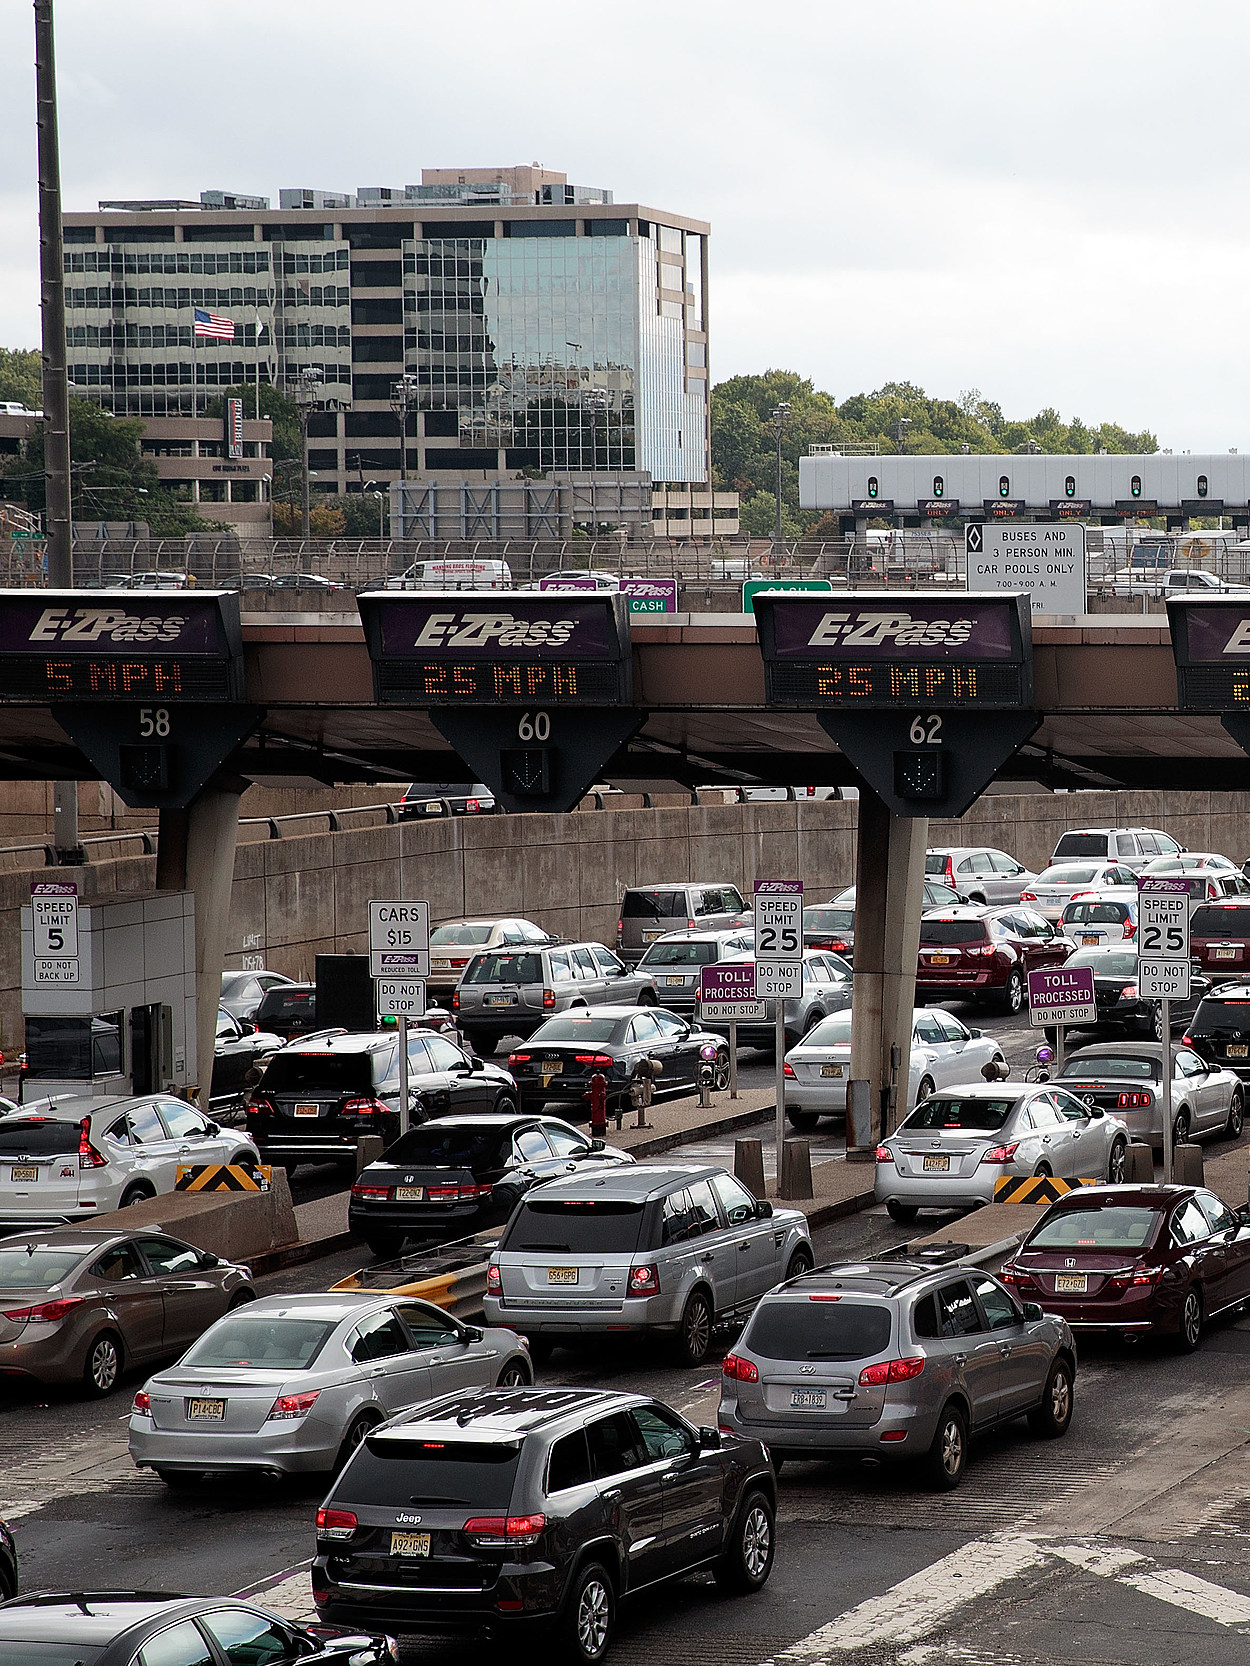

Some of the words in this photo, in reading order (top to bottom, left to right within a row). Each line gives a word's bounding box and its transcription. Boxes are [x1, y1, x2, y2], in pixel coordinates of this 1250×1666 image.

[1003, 532, 1037, 541] BUSES
[1045, 532, 1066, 541] AND
[993, 549, 1000, 557] 3
[1006, 548, 1048, 557] PERSON
[1055, 548, 1076, 557] MIN.
[977, 565, 998, 574] CAR
[1005, 565, 1040, 574] POOLS
[1047, 564, 1074, 574] ONLY
[622, 583, 675, 597] E-ZPass
[632, 601, 663, 611] CASH
[29, 609, 185, 642] E-ZPass
[415, 613, 576, 647] E-ZPass
[808, 612, 974, 647] E-ZPass
[46, 664, 72, 690] 5
[90, 664, 182, 692] MPH
[424, 666, 477, 694] 25
[500, 666, 578, 695] MPH
[817, 668, 873, 696] 25
[890, 668, 977, 697] MPH
[140, 709, 170, 737] 58
[518, 712, 550, 740] 60
[909, 715, 941, 744] 62
[34, 884, 75, 894] E-ZPass
[758, 882, 799, 892] E-ZPass
[1142, 880, 1186, 892] E-ZPass
[36, 902, 74, 913] SPEED
[760, 901, 797, 912] SPEED
[1144, 899, 1184, 911] SPEED
[41, 915, 70, 925] LIMIT
[379, 907, 419, 922] CARS
[764, 914, 794, 925] LIMIT
[1149, 913, 1180, 924] LIMIT
[47, 929, 64, 951] 5
[387, 928, 412, 946] $15
[759, 927, 798, 952] 25
[1144, 927, 1184, 951] 25
[383, 955, 417, 963] E-ZPass
[41, 962, 53, 970] DO
[57, 962, 72, 970] NOT
[759, 967, 774, 977] DO
[779, 967, 799, 977] NOT
[1144, 966, 1159, 977] DO
[1163, 966, 1185, 977] NOT
[39, 971, 62, 980] BACK
[64, 971, 75, 980] UP
[717, 972, 748, 983] TOLL
[1044, 975, 1078, 987] TOLL
[382, 985, 396, 995] DO
[401, 985, 420, 996] NOT
[767, 982, 792, 993] STOP
[1151, 981, 1178, 993] STOP
[1033, 990, 1091, 1004] PROCESSED
[389, 1000, 415, 1010] STOP
[707, 1006, 719, 1015] DO
[722, 1005, 737, 1015] NOT
[739, 1005, 759, 1015] STOP
[1037, 1011, 1049, 1021] DO
[1052, 1010, 1067, 1020] NOT
[1070, 1008, 1089, 1019] STOP
[395, 1512, 423, 1525] Jeep
